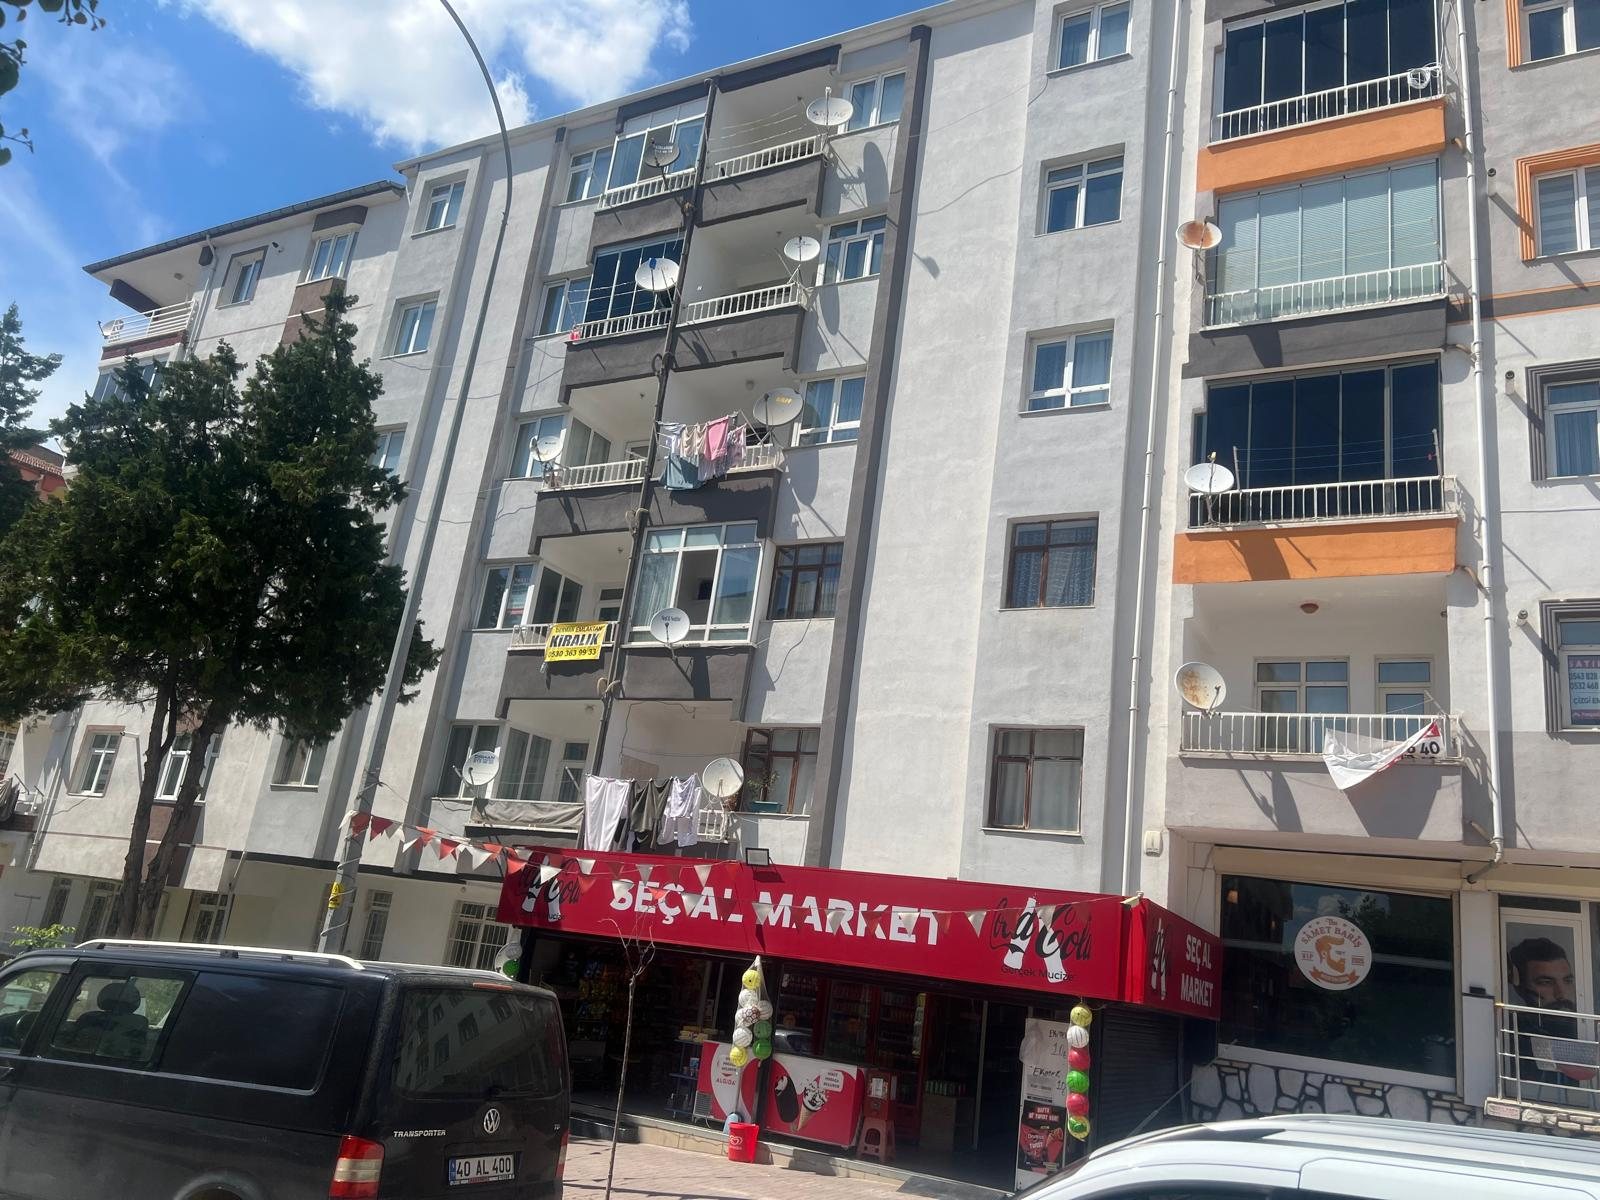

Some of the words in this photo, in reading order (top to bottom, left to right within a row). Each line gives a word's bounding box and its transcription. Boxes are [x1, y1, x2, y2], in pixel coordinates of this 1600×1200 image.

[1420, 741, 1440, 755] 40
[757, 891, 939, 946] MARKET
[1301, 926, 1332, 945] SAMET
[1180, 973, 1214, 1008] MARKET
[393, 1129, 447, 1138] TRANSPORTER
[456, 1160, 471, 1178] 40
[475, 1159, 490, 1176] AL
[492, 1156, 512, 1174] 400
